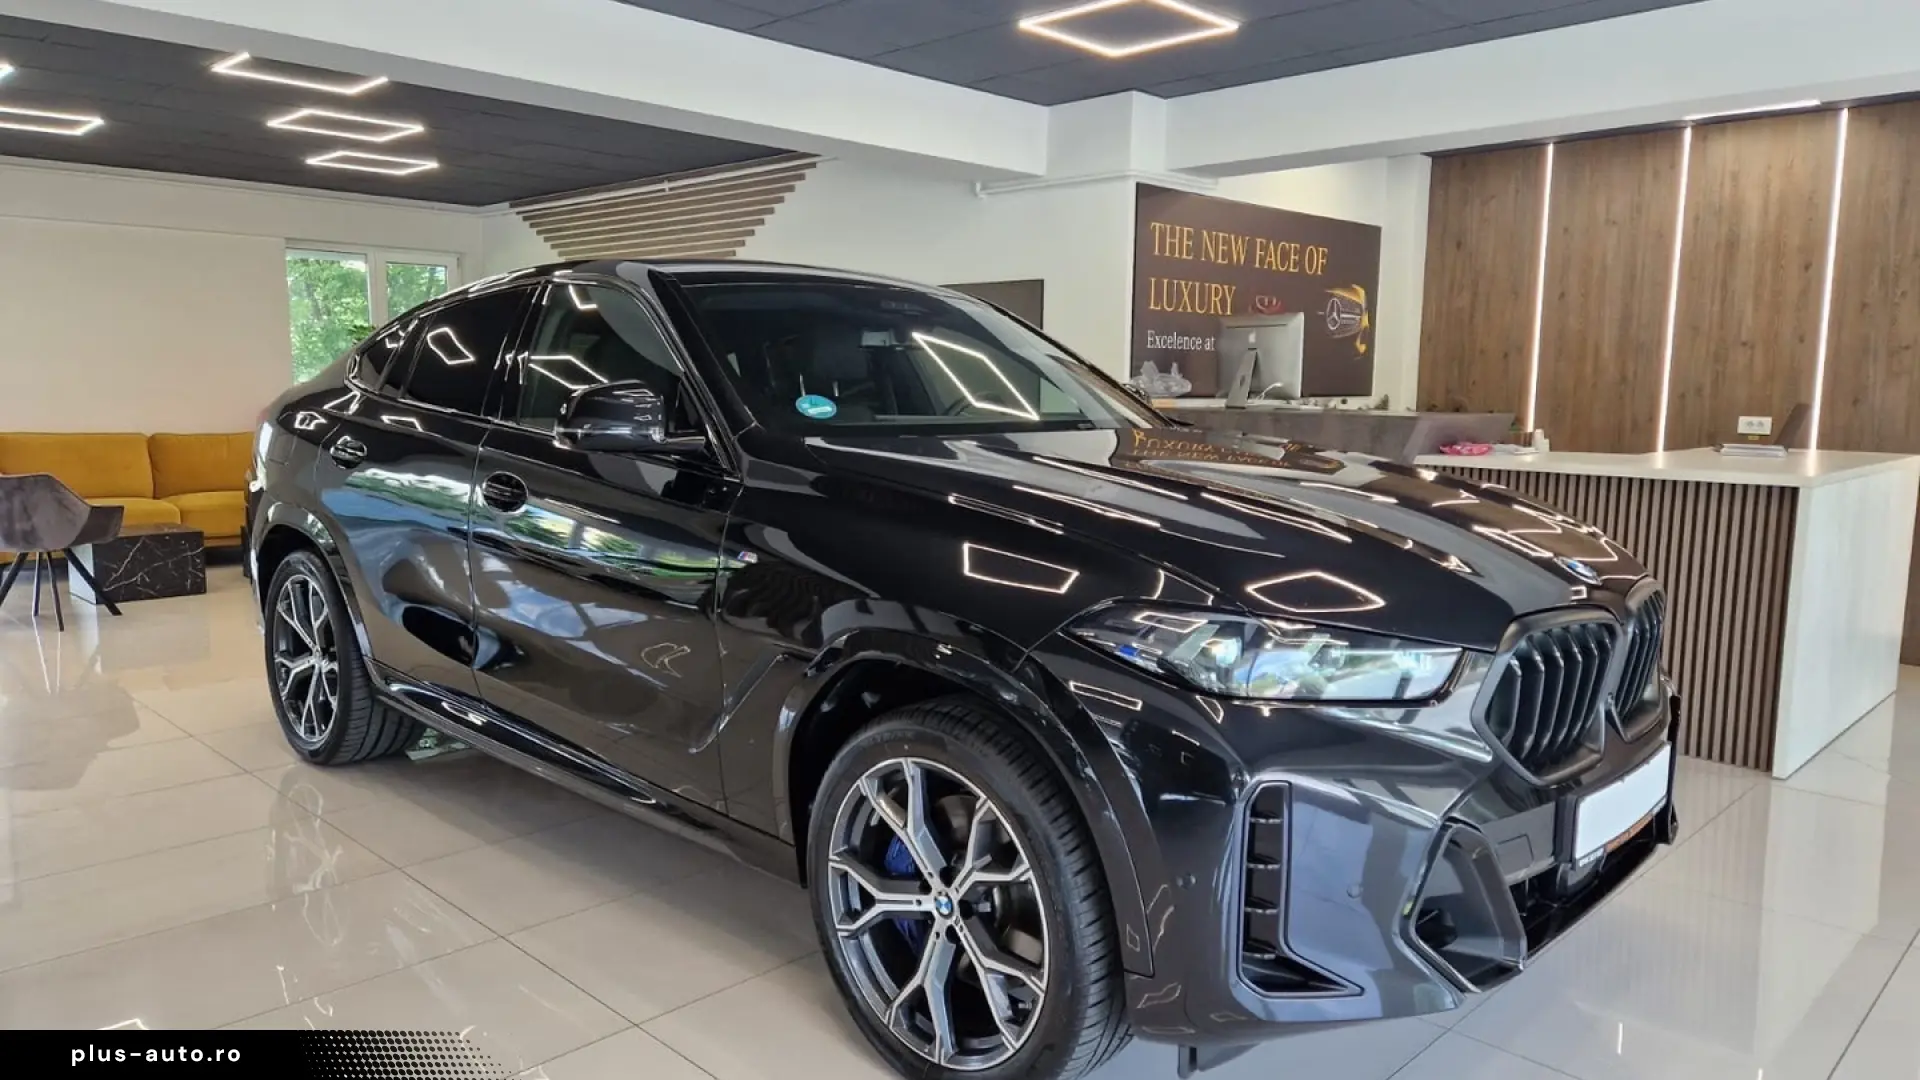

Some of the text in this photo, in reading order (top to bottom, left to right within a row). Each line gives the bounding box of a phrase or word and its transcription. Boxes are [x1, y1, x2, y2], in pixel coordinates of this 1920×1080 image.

[1150, 221, 1329, 276] THE NEW FACE OF
[1148, 276, 1237, 316] LUXURY
[1146, 329, 1216, 351] Excelence at
